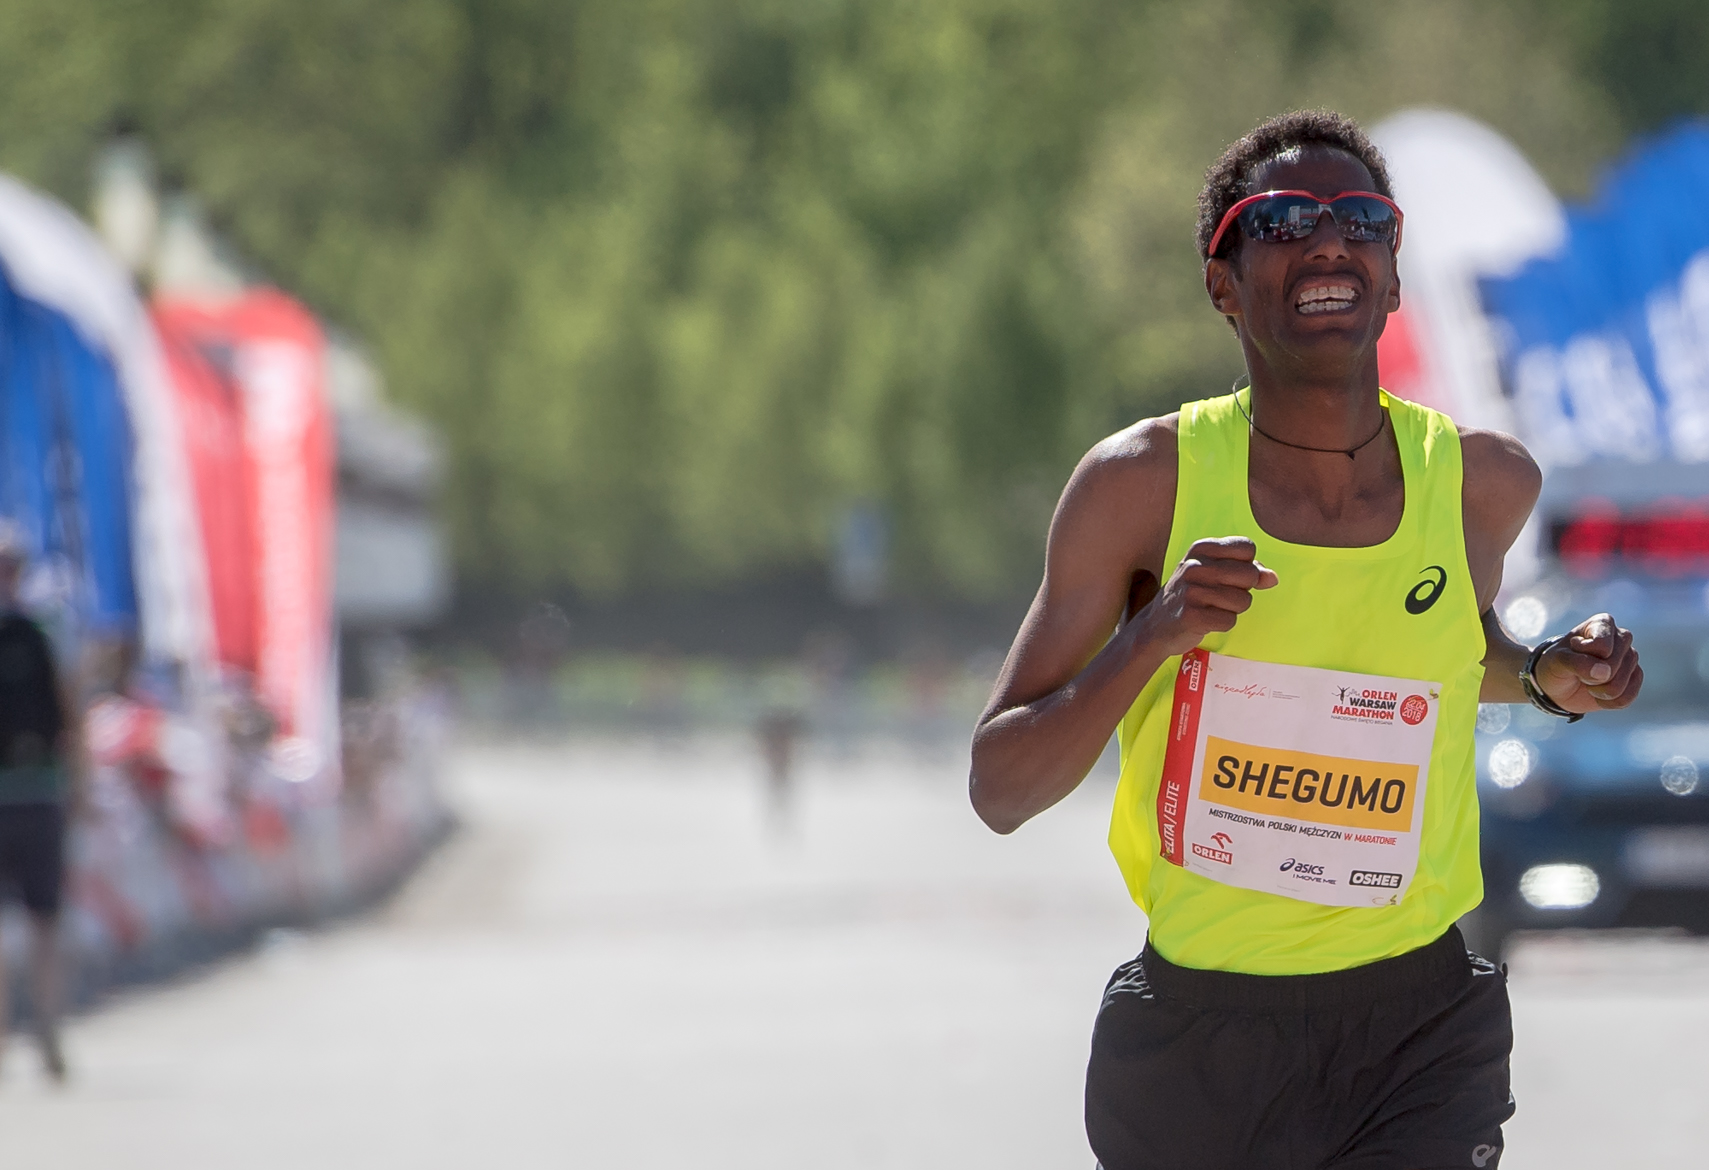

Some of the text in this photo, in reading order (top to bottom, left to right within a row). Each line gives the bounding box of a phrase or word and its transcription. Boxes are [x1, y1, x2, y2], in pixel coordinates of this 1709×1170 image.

[1190, 660, 1200, 689] ORLEN
[1362, 689, 1398, 701] ORLEN
[1349, 697, 1397, 710] WARSAW
[1332, 705, 1395, 720] MARATHON
[1402, 707, 1422, 722] 2018
[1213, 755, 1406, 814] SHEGUMO
[1208, 808, 1397, 845] MISTRZOSTWA POLSKI MĘŻCZYZN W MARATONIE
[1194, 845, 1230, 862] ORLEN
[1296, 874, 1322, 883] MOVE
[1352, 872, 1400, 887] OSHEE
